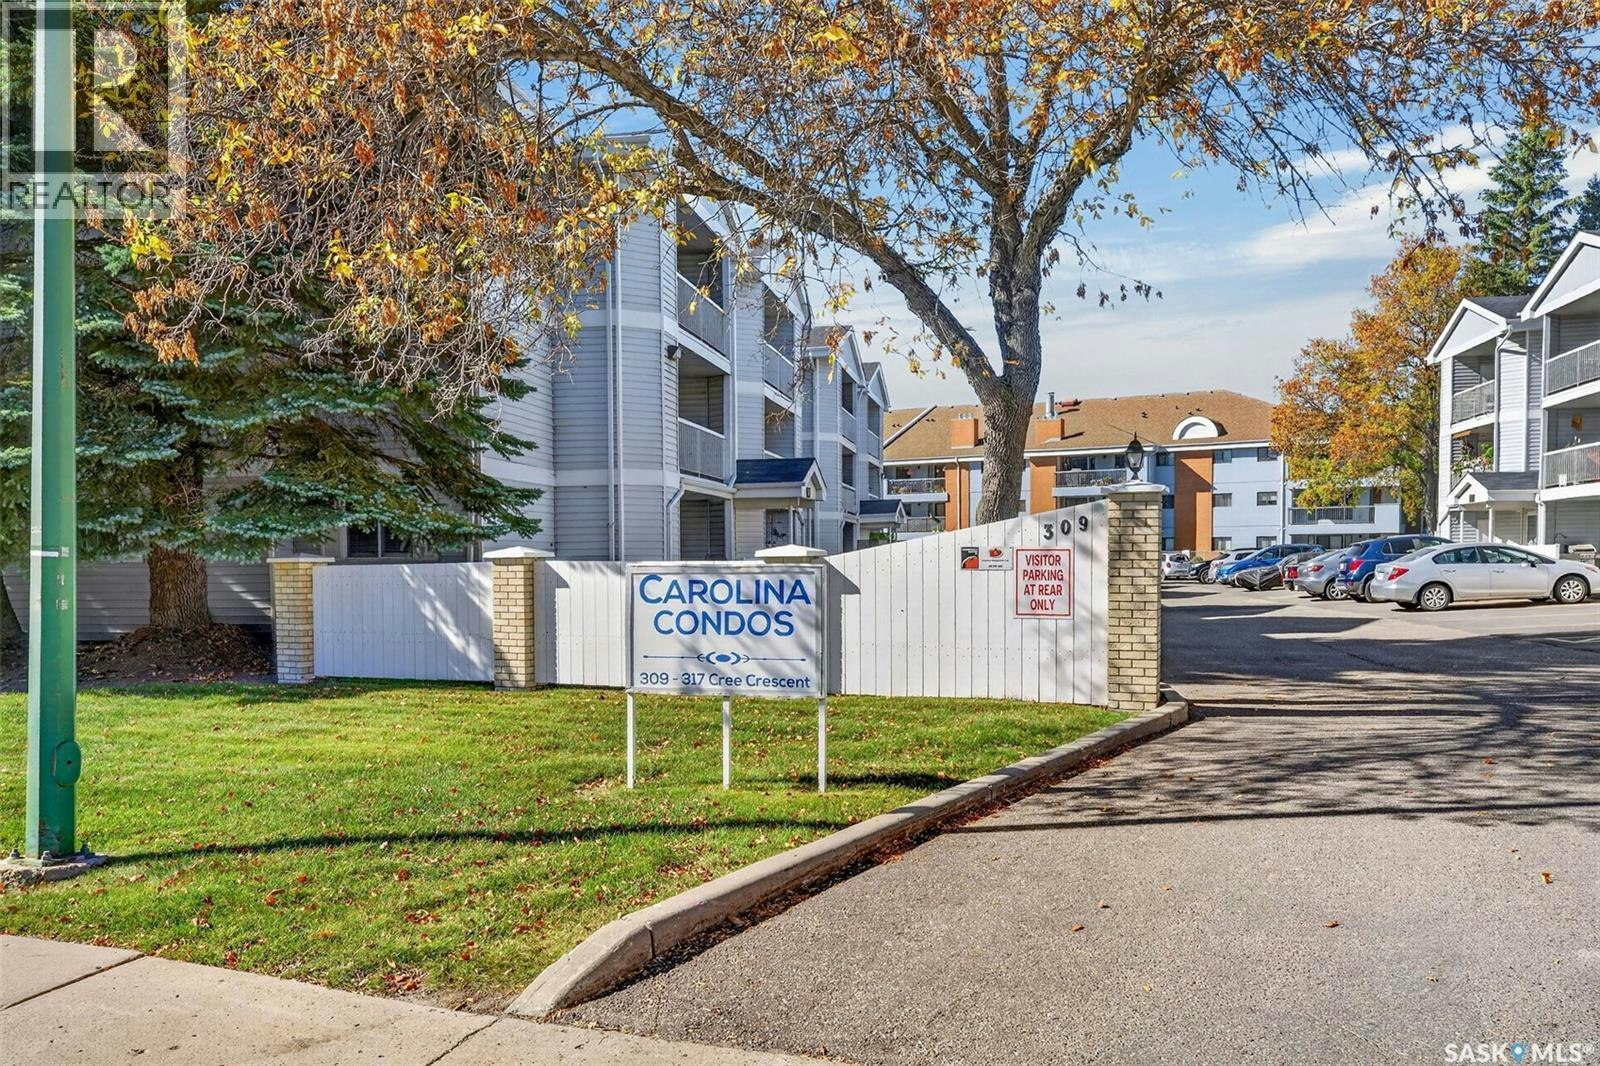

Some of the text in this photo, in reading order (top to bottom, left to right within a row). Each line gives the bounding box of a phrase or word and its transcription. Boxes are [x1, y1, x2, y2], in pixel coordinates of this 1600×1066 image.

[1043, 515, 1089, 540] 309
[1025, 554, 1061, 566] VISITOR
[1023, 569, 1063, 581] PARKING
[639, 574, 811, 605] CAROLINA
[1024, 584, 1062, 596] AT REAR
[1030, 599, 1055, 610] ONLY
[653, 609, 794, 637] CONDOS
[640, 672, 669, 685] 309
[681, 673, 705, 686] 317
[708, 673, 742, 686] Cree
[746, 675, 811, 688] Crescent
